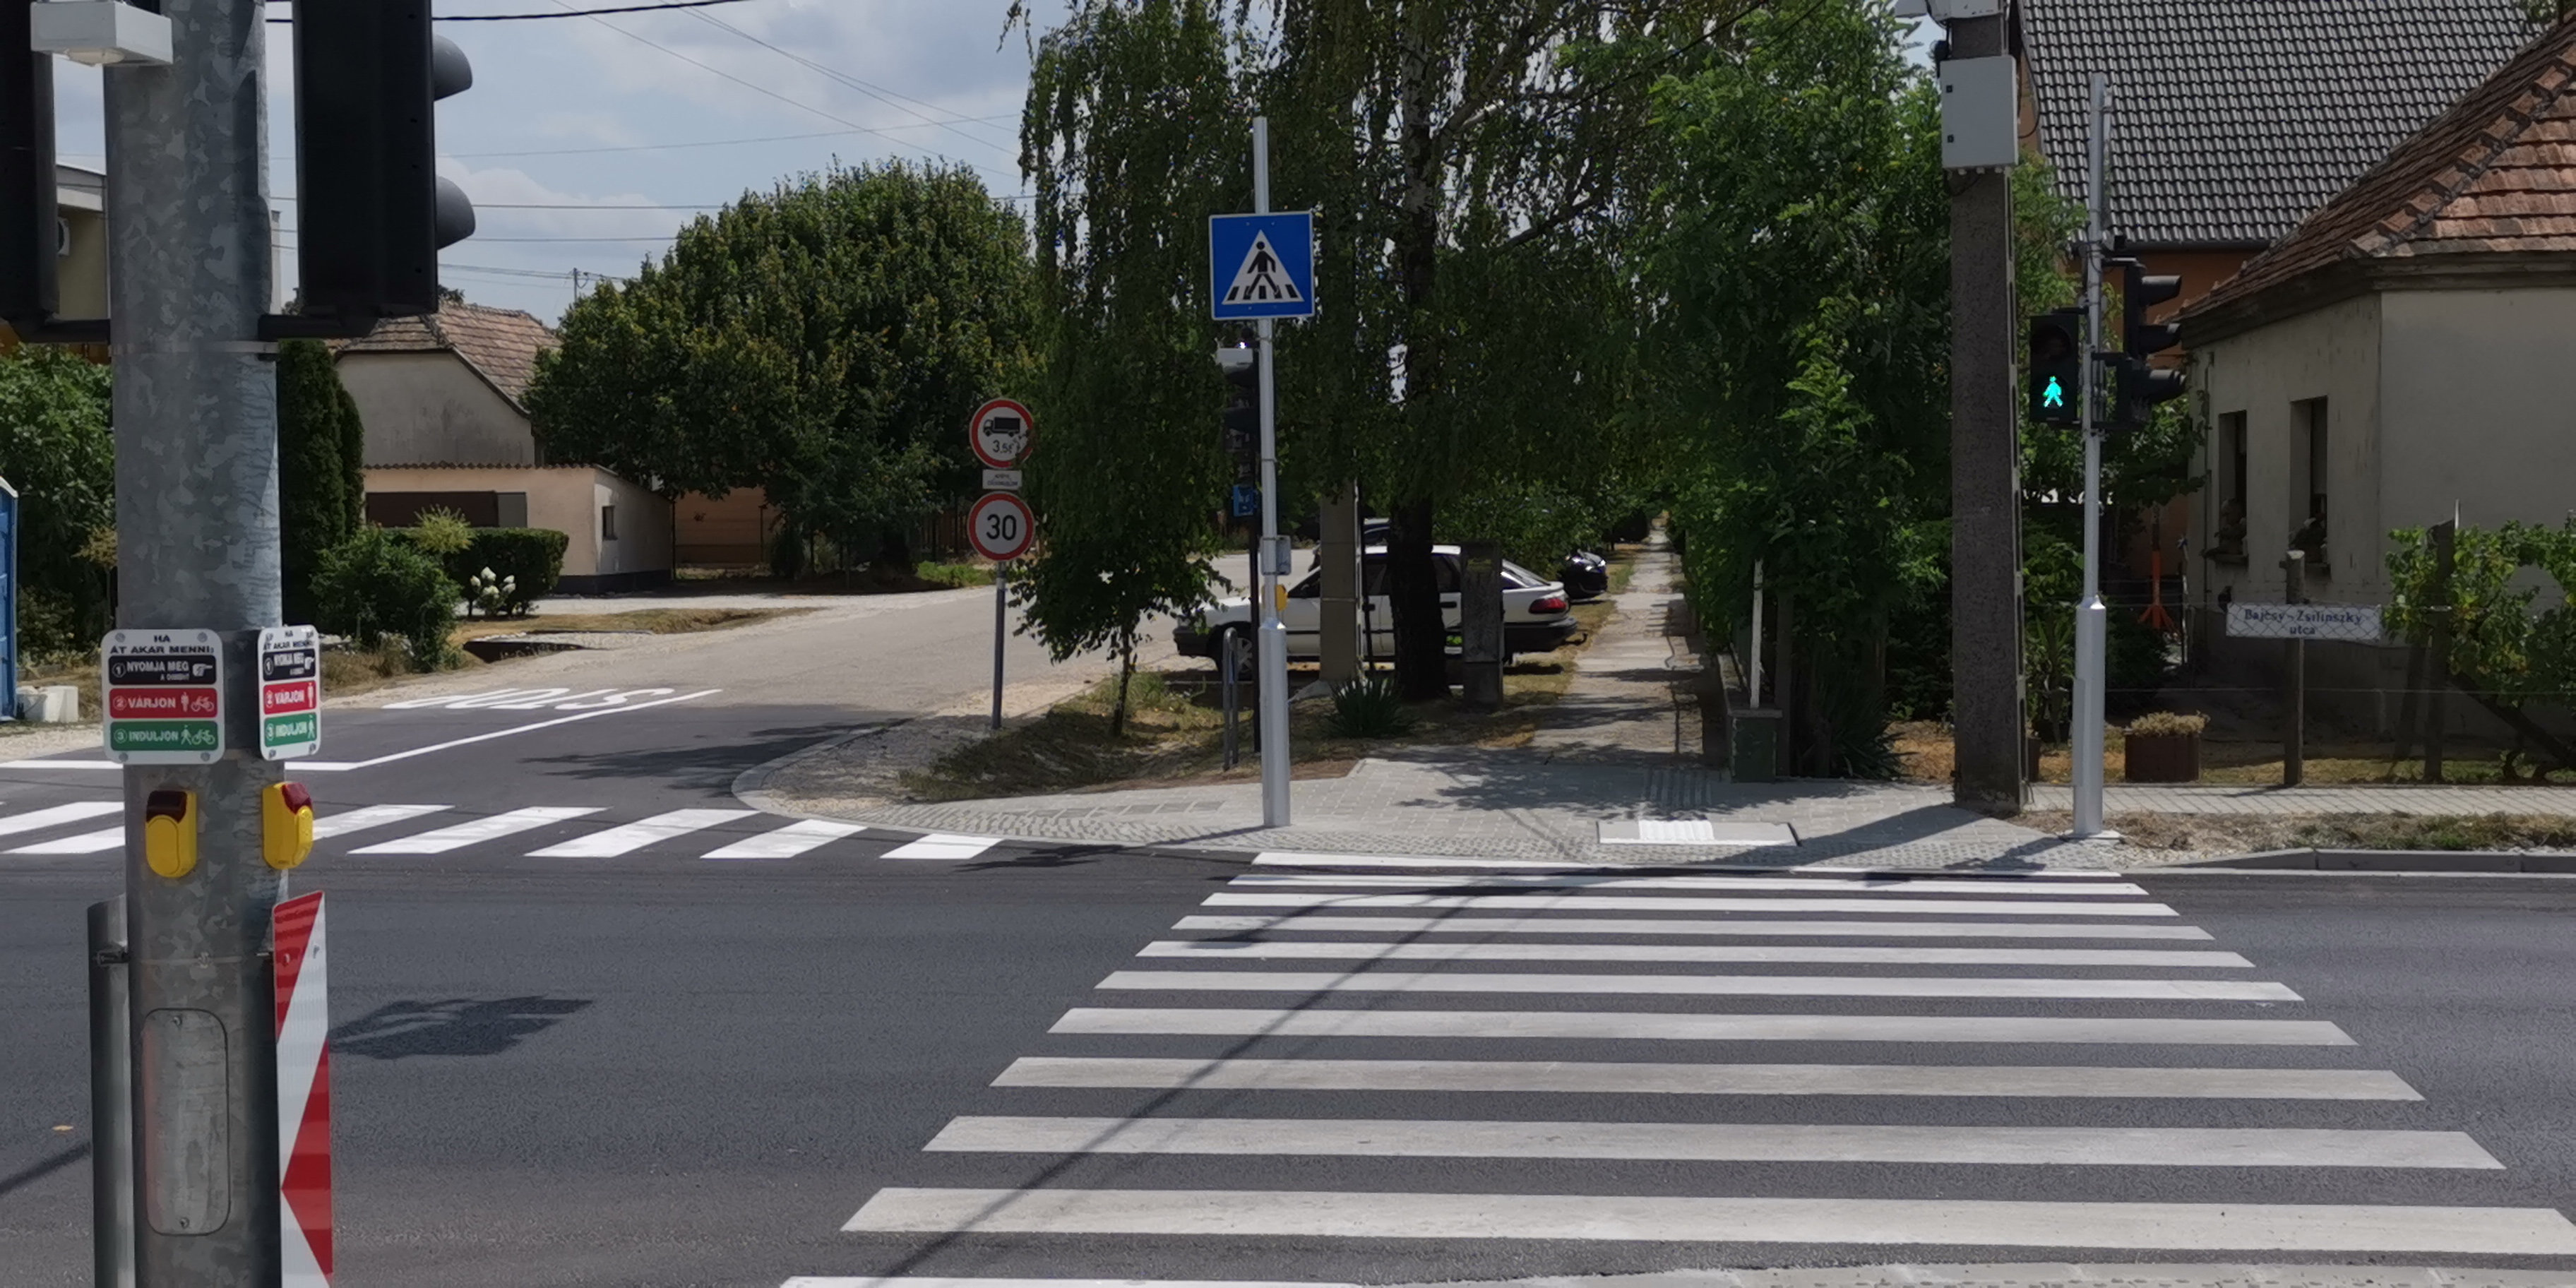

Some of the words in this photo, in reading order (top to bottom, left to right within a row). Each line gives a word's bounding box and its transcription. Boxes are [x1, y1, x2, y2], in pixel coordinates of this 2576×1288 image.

[986, 513, 1017, 541] 30
[2289, 625, 2316, 636] utca
[131, 645, 165, 654] AKAR
[126, 661, 166, 672] NYOMJA
[167, 660, 190, 672] MEG
[127, 695, 177, 709] VÁRJON
[129, 730, 179, 741] INDULJON
